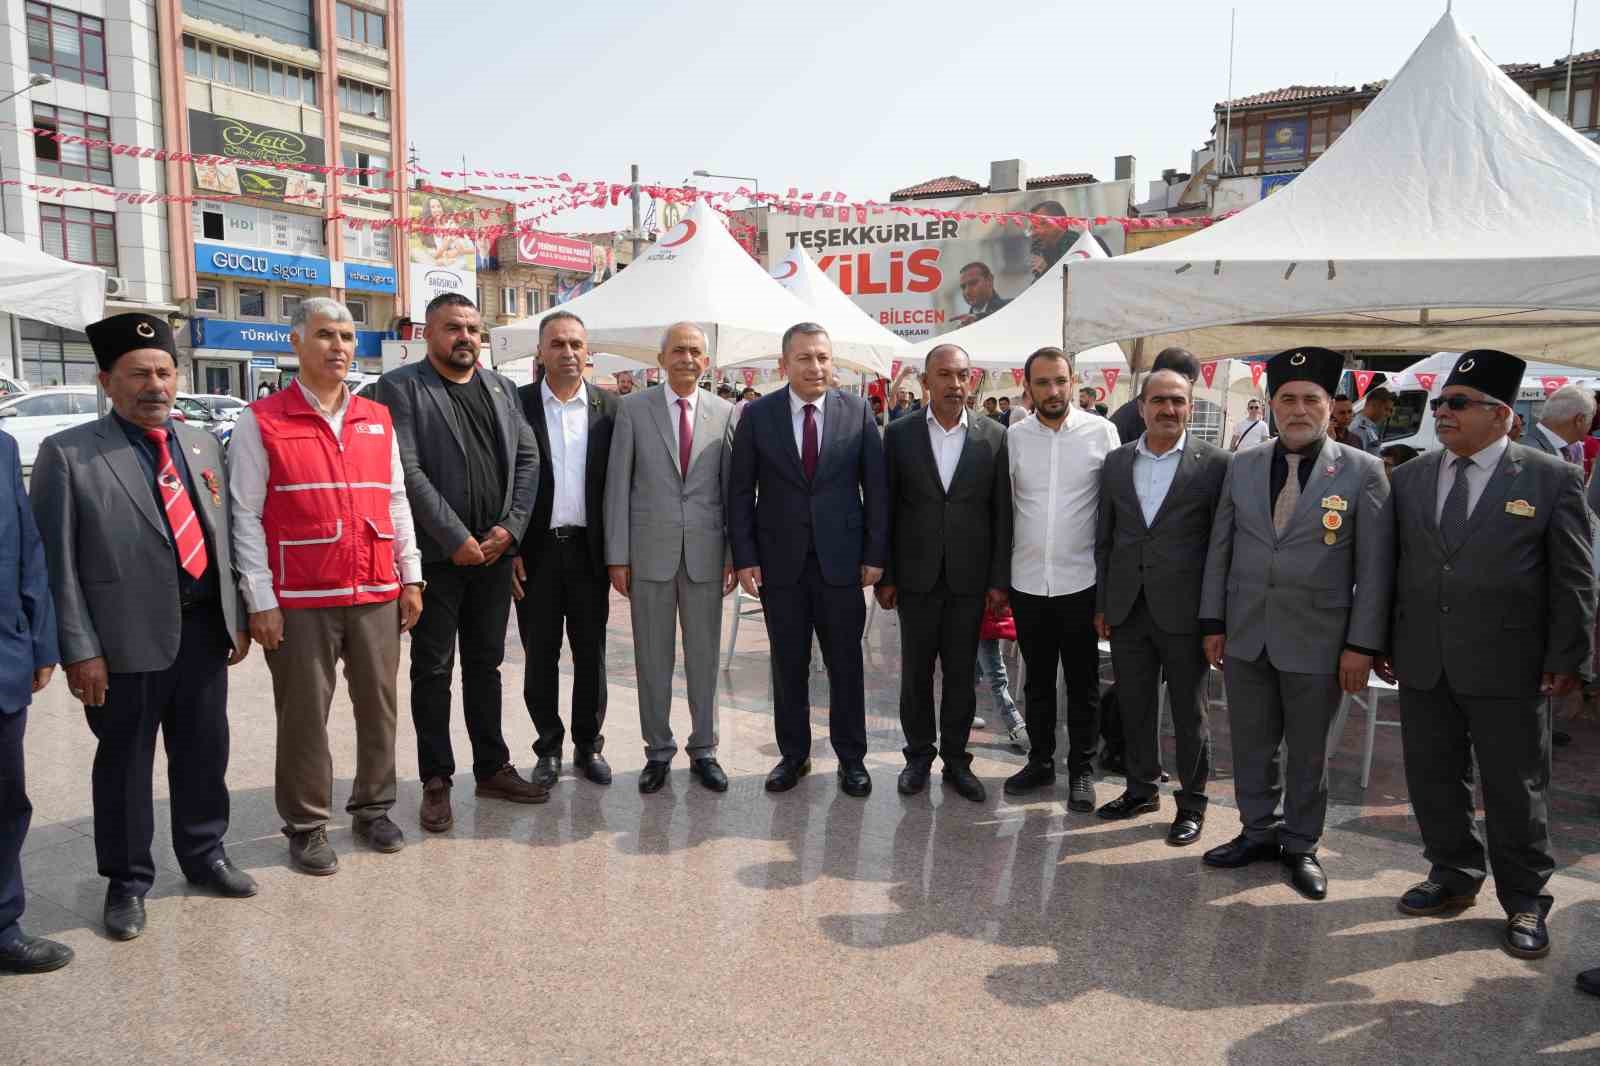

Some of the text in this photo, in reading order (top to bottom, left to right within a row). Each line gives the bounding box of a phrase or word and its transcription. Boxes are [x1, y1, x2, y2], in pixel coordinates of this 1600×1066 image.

[230, 218, 257, 231] HDI
[786, 219, 959, 253] TEŞEKKÜRLER
[272, 263, 318, 280] sigorta
